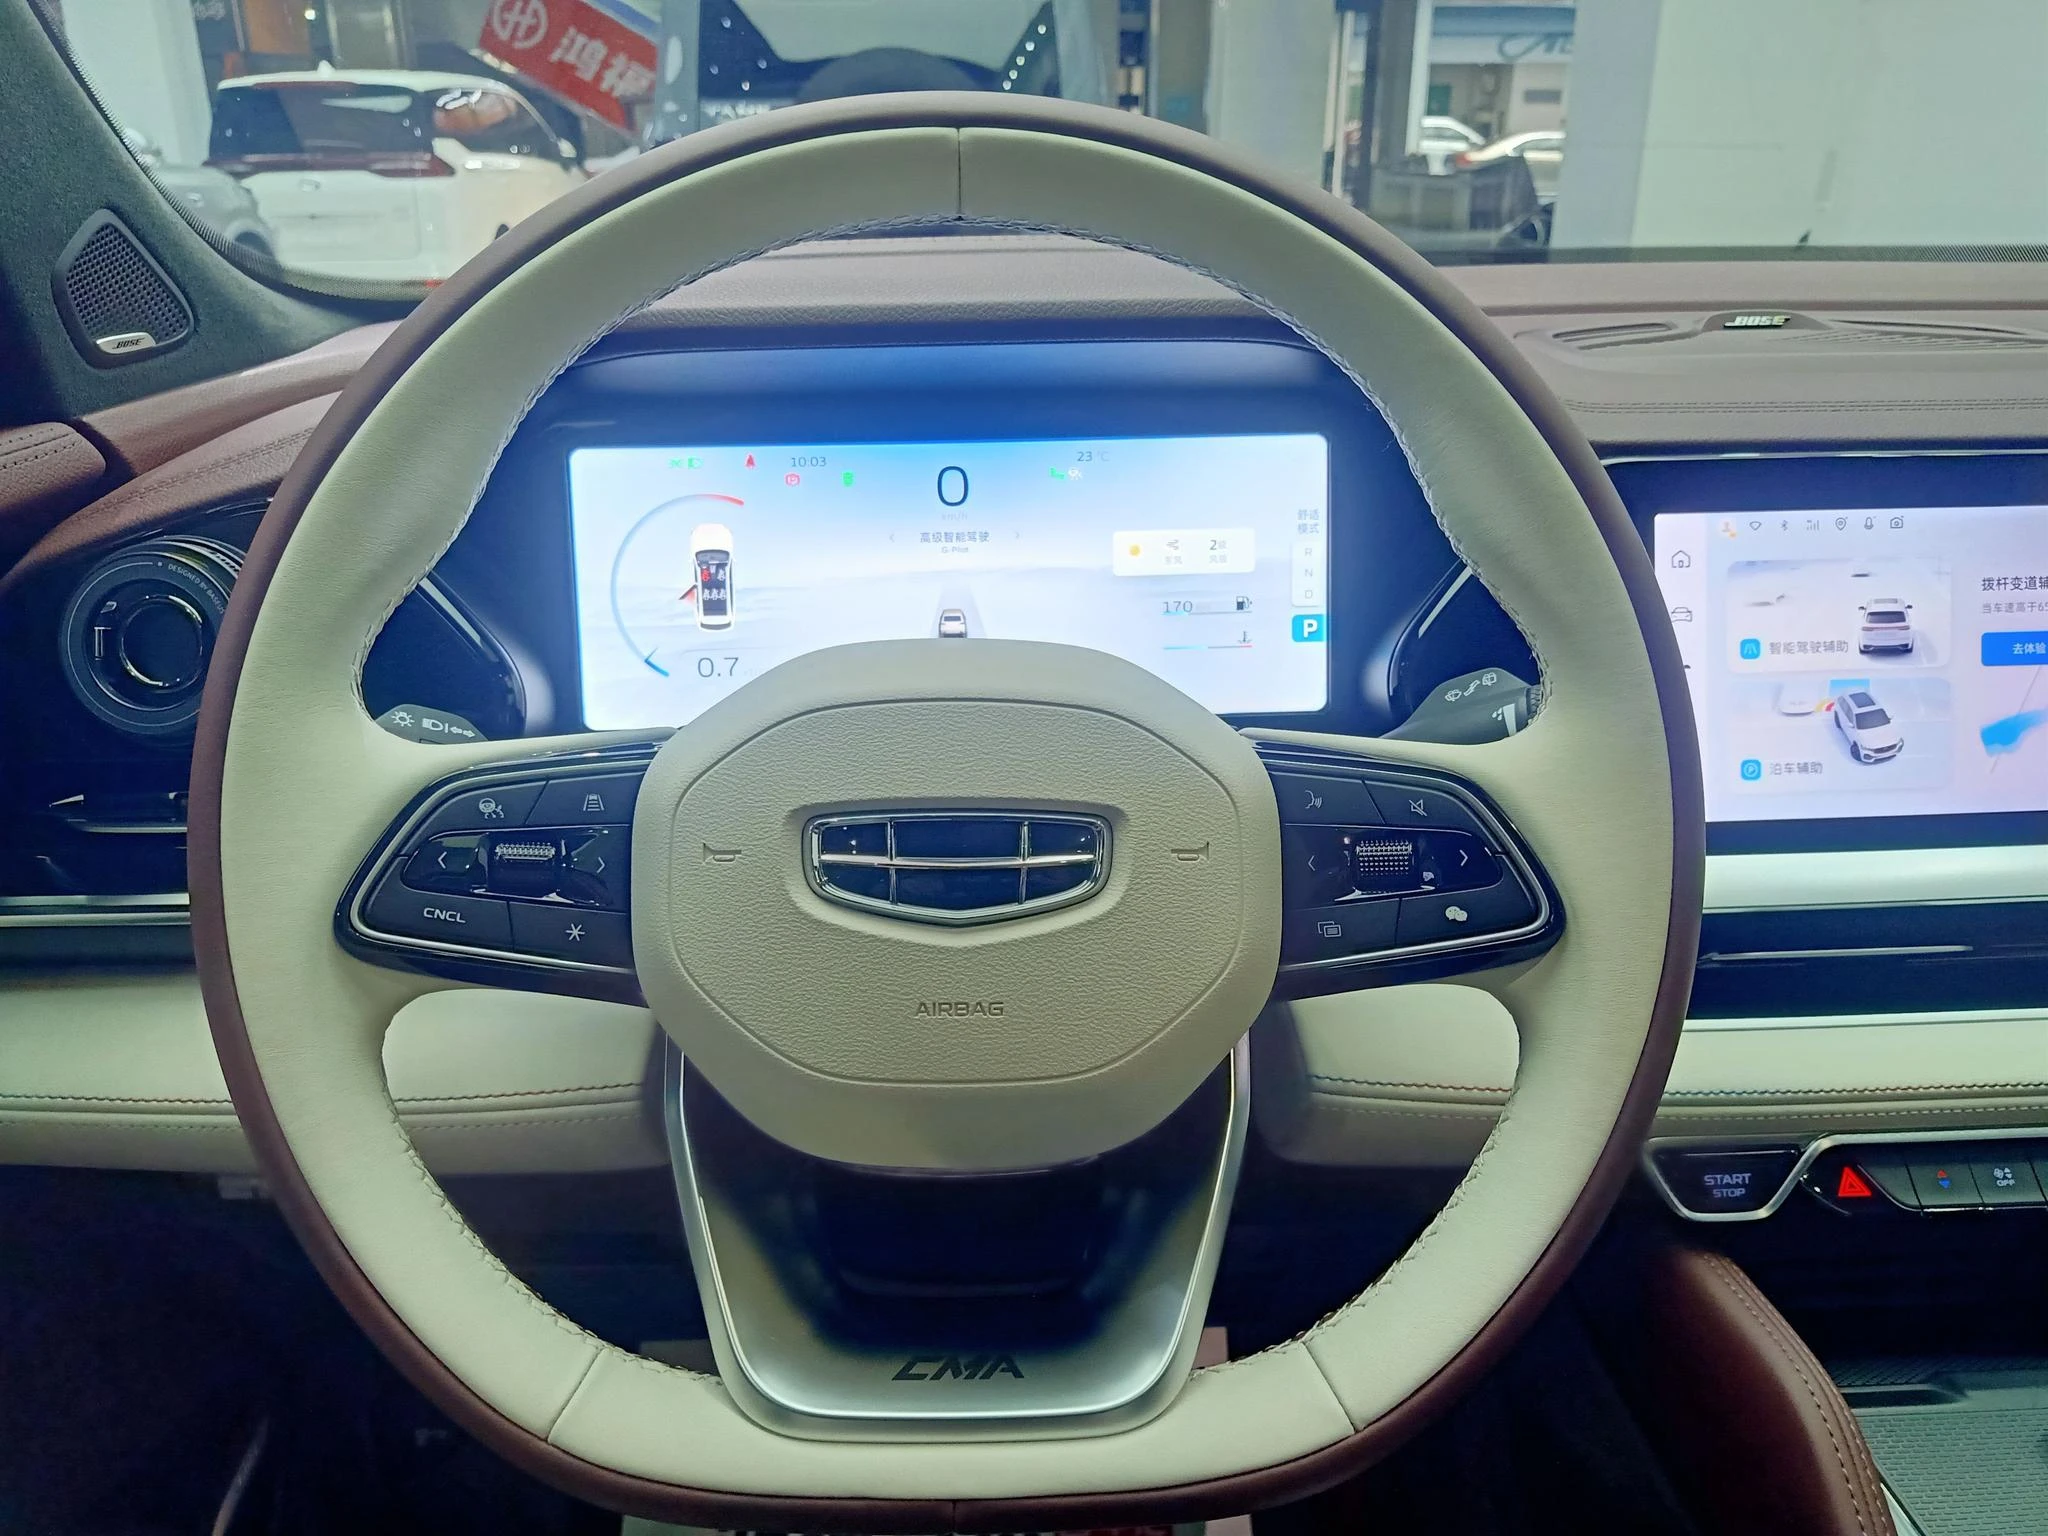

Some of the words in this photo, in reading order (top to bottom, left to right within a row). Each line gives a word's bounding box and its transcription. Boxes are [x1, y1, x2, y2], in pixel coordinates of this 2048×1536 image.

[1724, 315, 1791, 328] BOSE
[112, 337, 146, 350] BOSE
[791, 455, 827, 467] 10:03
[1076, 450, 1092, 462] 23
[937, 465, 969, 507] 0
[919, 531, 989, 543] 高级智能驾驶
[1304, 547, 1313, 556] R
[168, 563, 201, 584] DESIGNED
[1304, 568, 1313, 577] N
[1163, 600, 1193, 613] 170
[1303, 619, 1319, 640] P
[1769, 640, 1849, 655] 智能驾驶辅助
[2012, 642, 2047, 655] 去体验
[697, 656, 739, 678] 0.7
[1769, 761, 1824, 775] 泊车辅助
[423, 907, 467, 924] CNCL
[915, 1001, 1004, 1018] AIRBAG
[1703, 1173, 1752, 1186] START
[1712, 1188, 1746, 1198] STOP
[891, 1354, 1025, 1381] CMA
